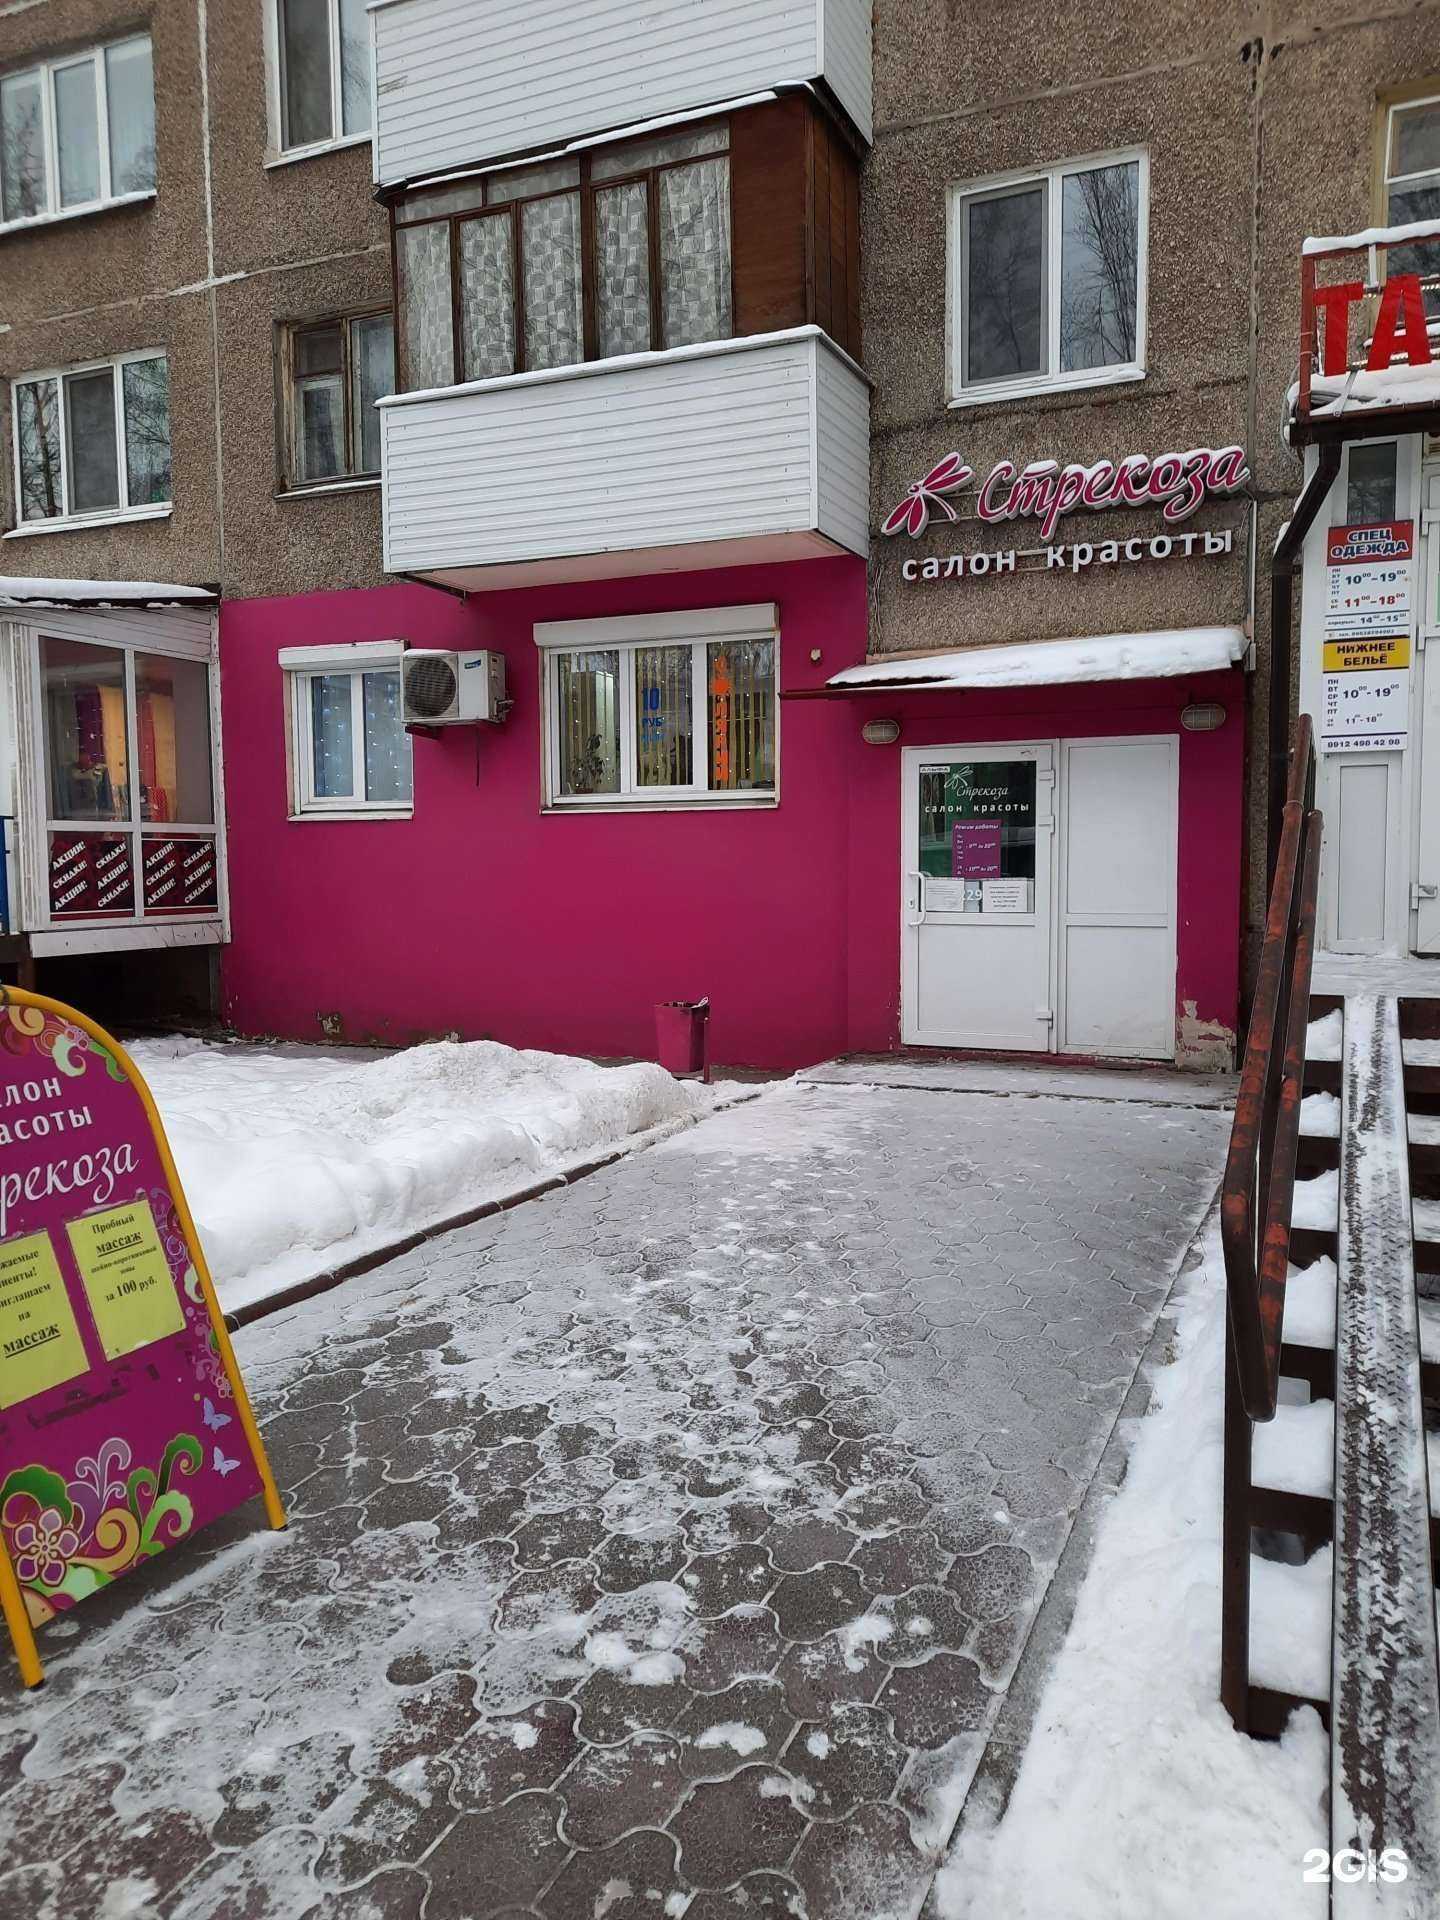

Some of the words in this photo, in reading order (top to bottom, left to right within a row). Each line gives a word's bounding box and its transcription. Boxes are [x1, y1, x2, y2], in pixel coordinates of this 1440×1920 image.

[1313, 273, 1432, 377] ТА
[977, 445, 1250, 541] Стрекоза
[1348, 528, 1392, 543] СПЕЦ
[902, 549, 1015, 581] салон
[1047, 530, 1232, 573] красоты
[1331, 540, 1409, 559] ОДЕЖДА
[1337, 642, 1396, 654] НИЖНЕЕ
[1344, 653, 1388, 666] БЕЛЬЁ
[956, 785, 1008, 801] Стрекоза
[925, 805, 962, 813] салон
[973, 803, 1029, 813] красоты
[0, 1077, 62, 1108] лон
[92, 1213, 135, 1234] Пробный
[96, 1231, 143, 1256] массаж
[0, 1266, 37, 1288] иенты!
[116, 1280, 137, 1297] 100
[138, 1276, 158, 1292] руб.
[0, 1283, 51, 1308] иглашаем
[3, 1323, 60, 1356] массаж
